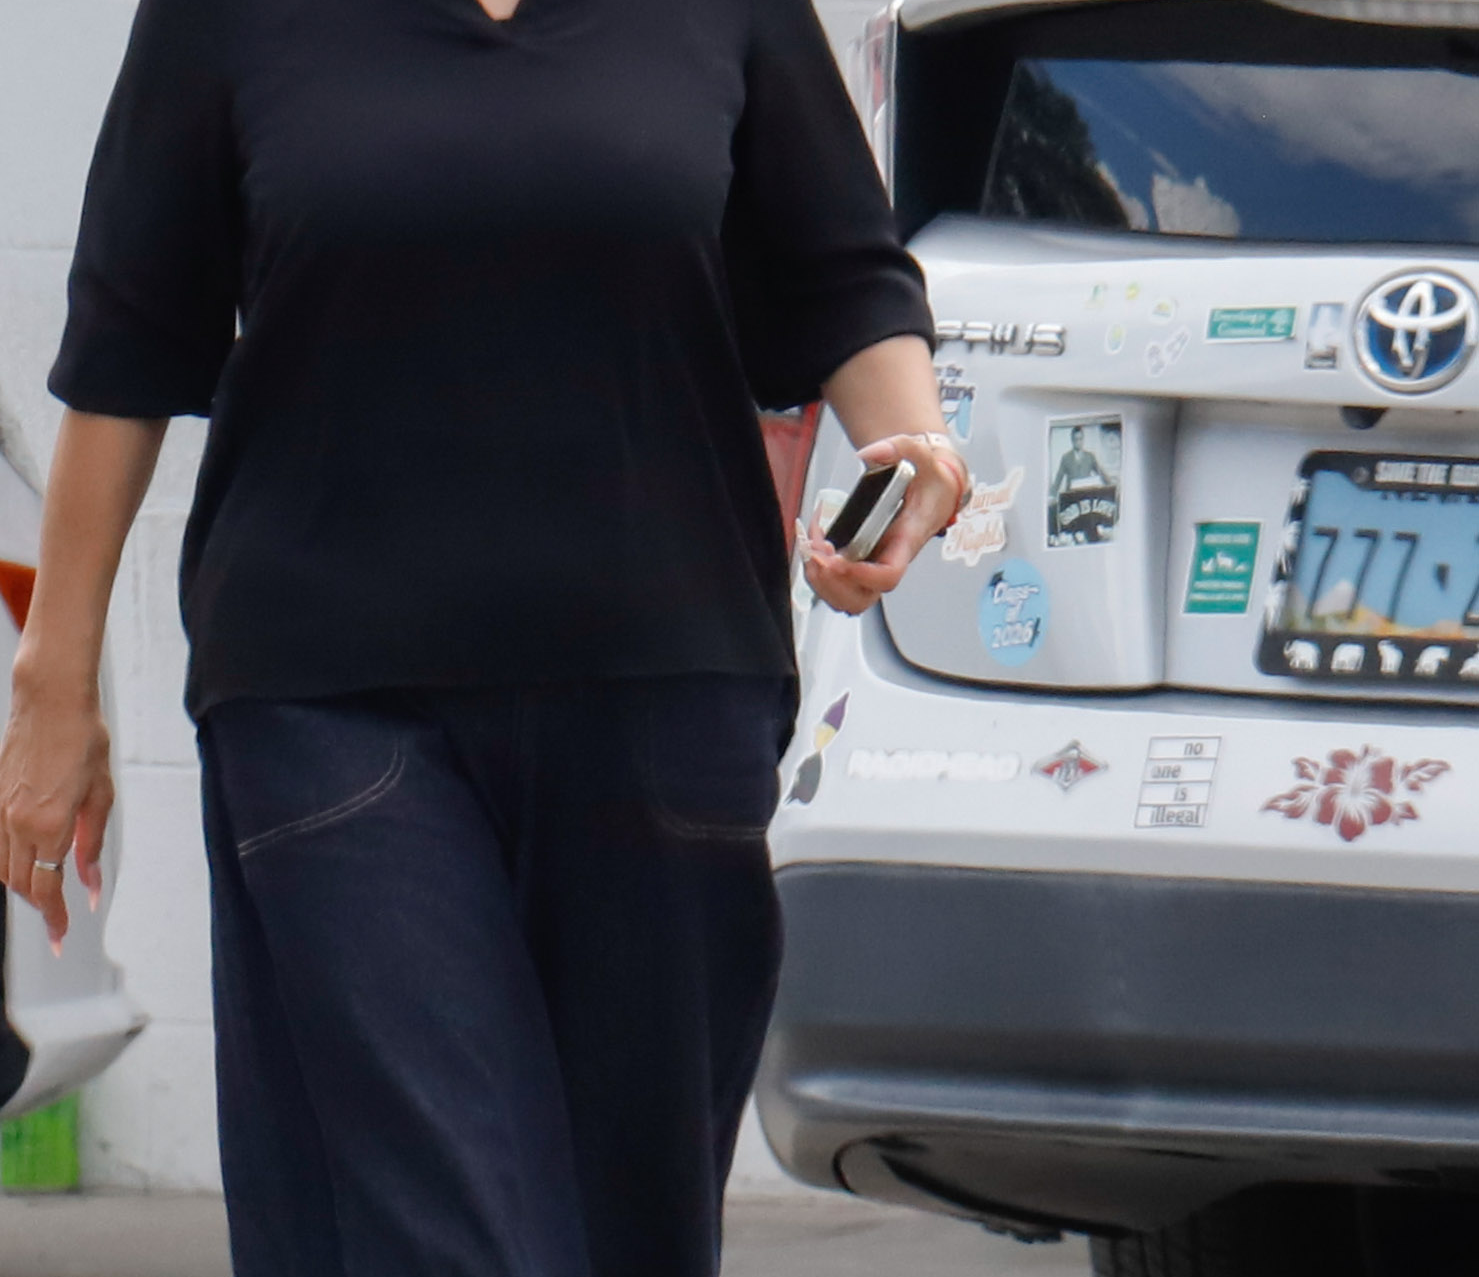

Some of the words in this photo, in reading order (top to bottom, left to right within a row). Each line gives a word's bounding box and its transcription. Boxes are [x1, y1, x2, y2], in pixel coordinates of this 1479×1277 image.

[1183, 742, 1205, 756] no
[1151, 764, 1182, 779] one
[1172, 783, 1188, 802] is
[1149, 804, 1200, 825] illegal
